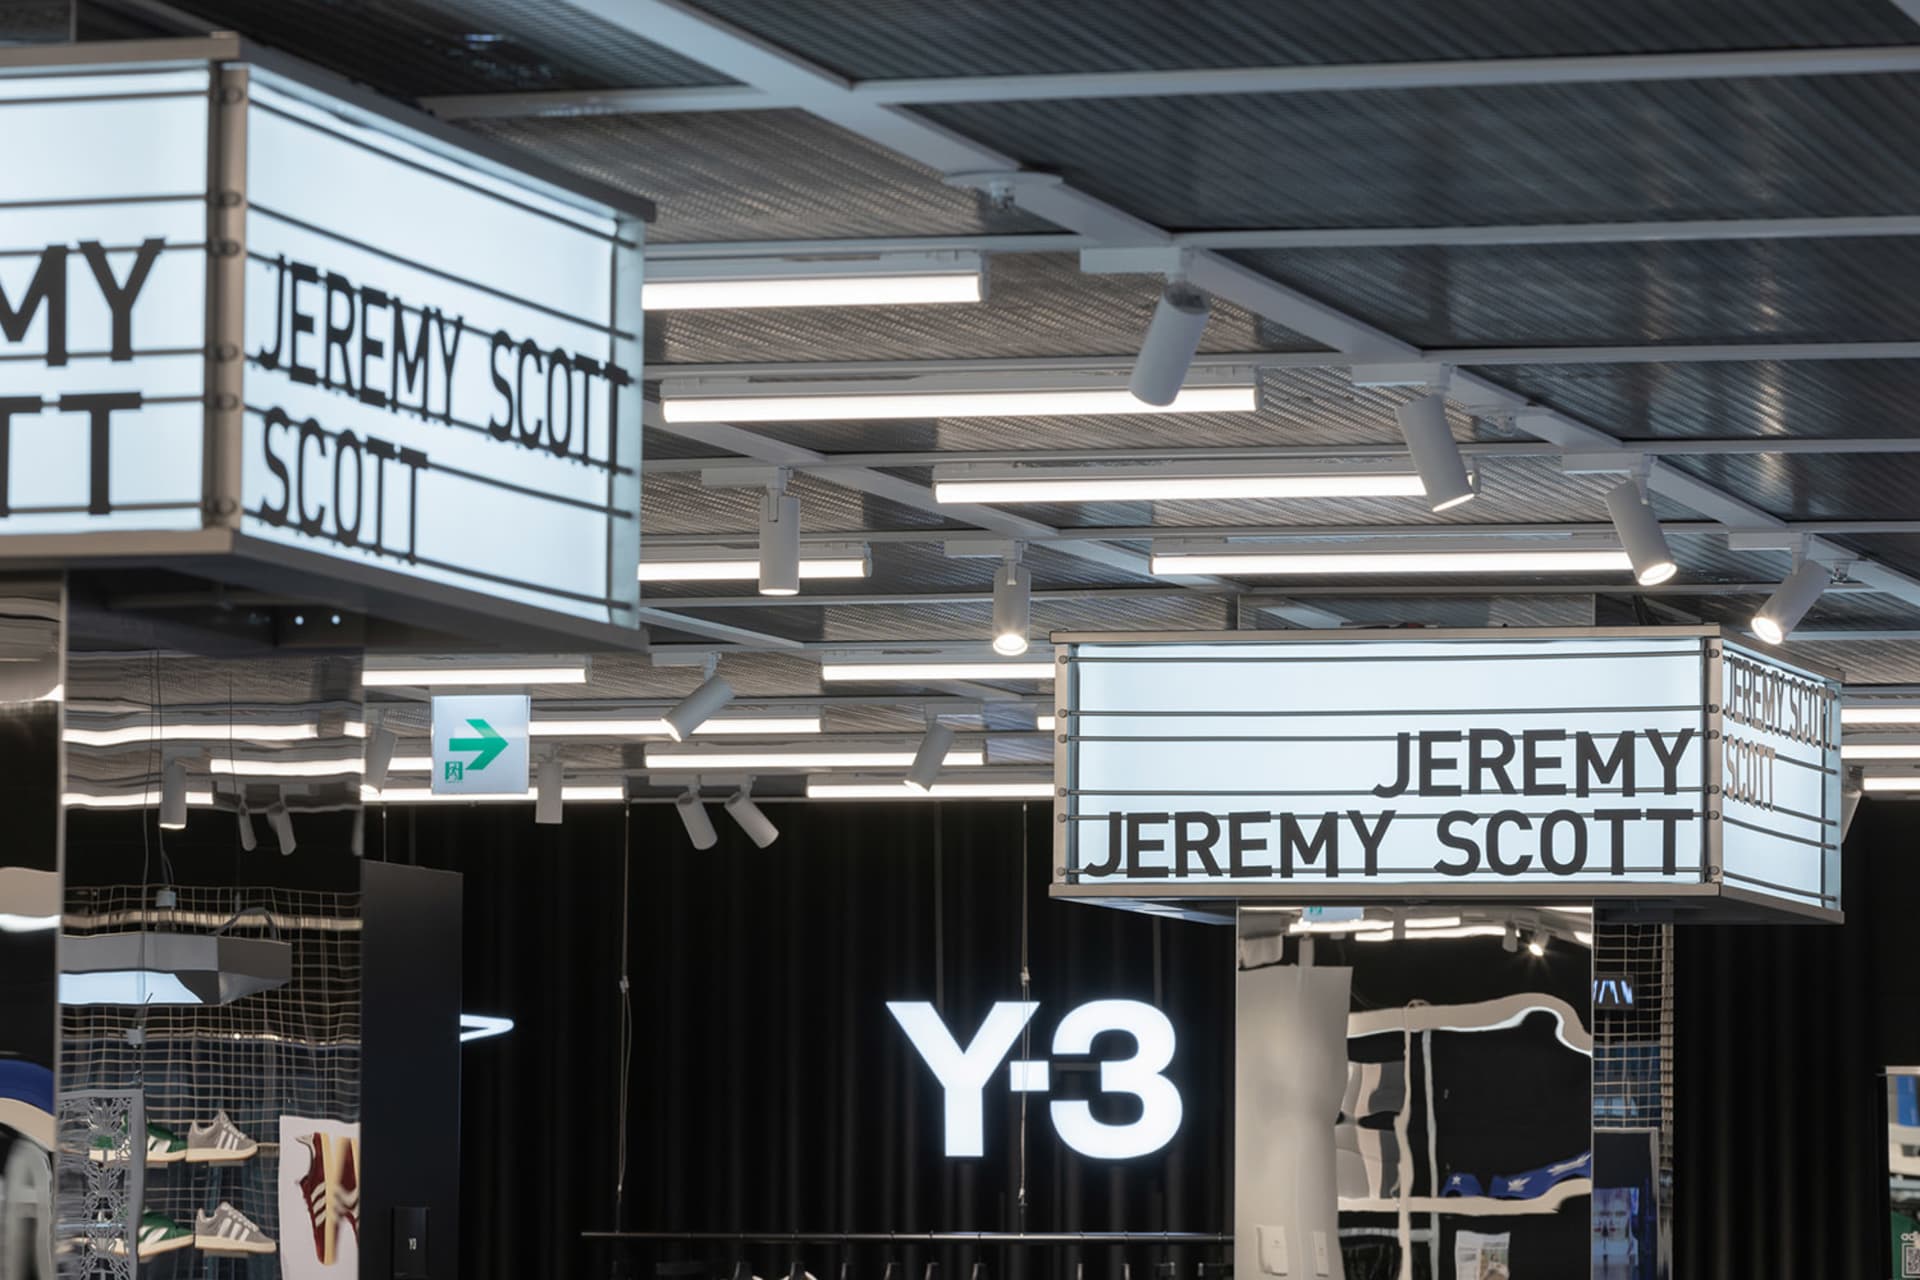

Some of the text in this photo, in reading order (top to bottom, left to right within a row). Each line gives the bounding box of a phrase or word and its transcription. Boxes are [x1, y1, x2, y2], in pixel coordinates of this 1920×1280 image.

[260, 254, 630, 475] JEREMY SCOTT
[261, 406, 428, 565] SCOTT
[1726, 654, 1837, 752] JEREMY SCOTT
[1372, 728, 1696, 798] JEREMY
[1726, 734, 1776, 811] SCOTT
[1083, 809, 1694, 878] JEREMY SCOTT
[885, 998, 1184, 1160] Y-3
